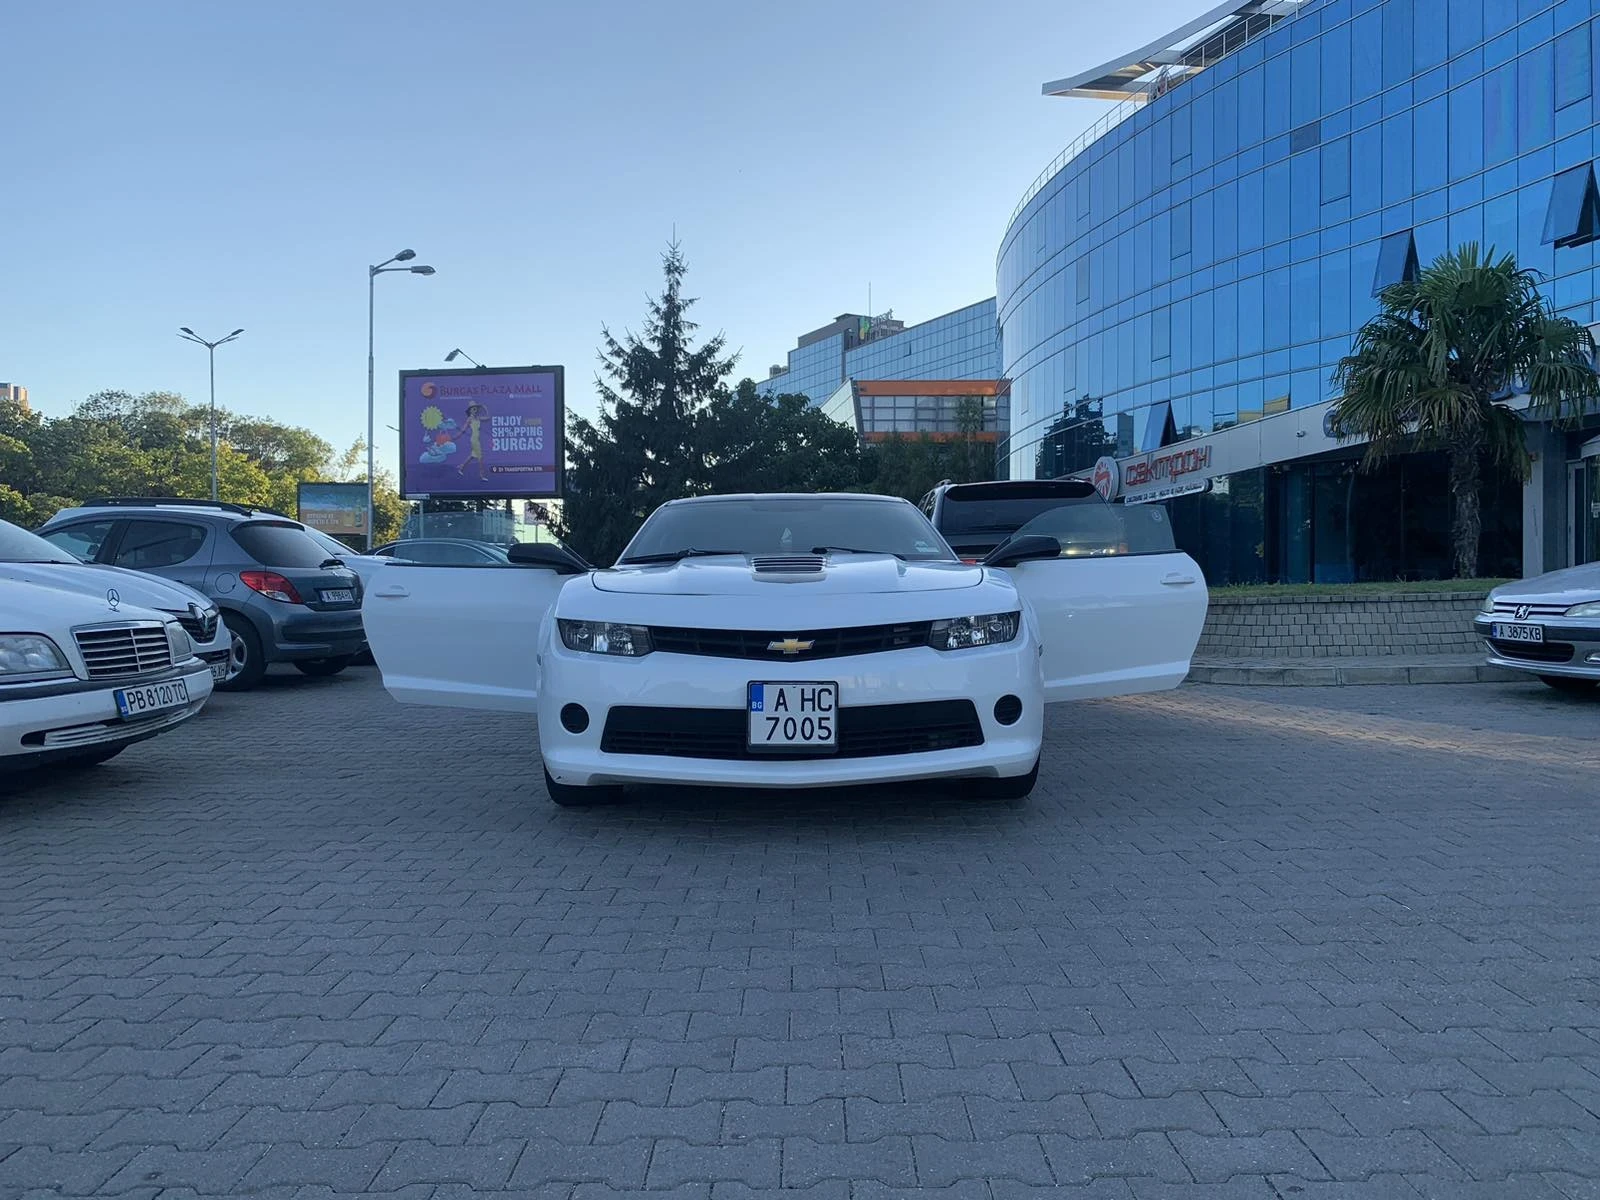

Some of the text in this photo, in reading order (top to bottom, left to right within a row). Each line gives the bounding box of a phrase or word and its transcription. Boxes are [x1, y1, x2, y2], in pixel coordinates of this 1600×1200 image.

[480, 384, 511, 394] PLAZA
[514, 383, 543, 393] MALL
[492, 416, 522, 426] ENJOY
[492, 438, 543, 451] BURGAS
[1500, 625, 1504, 637] A
[126, 682, 186, 711] PB 8120 TC
[774, 688, 832, 712] A HC
[752, 701, 762, 709] BG
[766, 716, 832, 740] 7005
